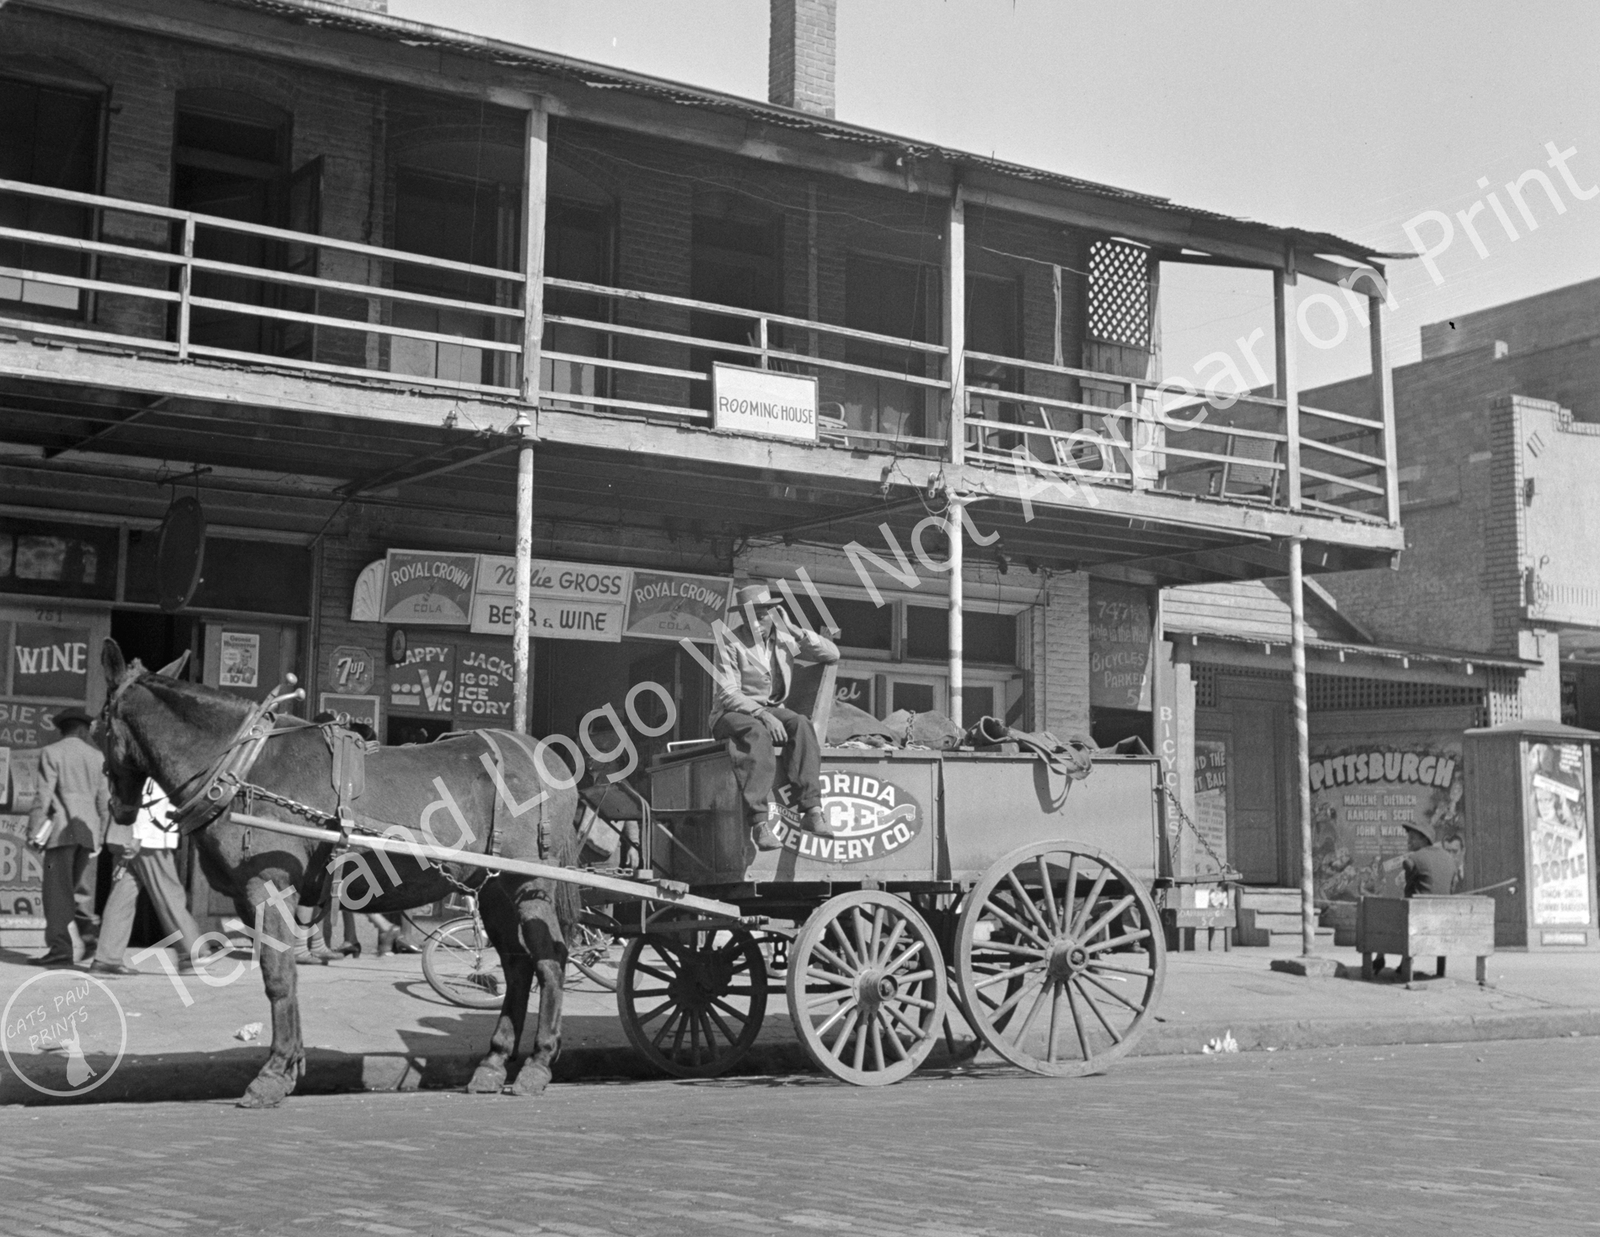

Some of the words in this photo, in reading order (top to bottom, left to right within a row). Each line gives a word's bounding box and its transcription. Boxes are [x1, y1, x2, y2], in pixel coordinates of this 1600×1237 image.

[719, 396, 779, 420] ROOMING
[781, 405, 813, 425] HOUSE
[391, 561, 430, 588] ROYAL
[432, 561, 472, 590] CROWN
[495, 564, 554, 588] Nlie
[559, 571, 622, 595] GROSS
[634, 581, 678, 604] ROYAL
[680, 582, 725, 611] CROWN
[413, 603, 442, 613] COLA
[489, 604, 537, 627] BER
[542, 618, 554, 629] &
[560, 609, 607, 631] WINE
[658, 621, 691, 632] COLA
[15, 642, 87, 675] WINE
[394, 646, 449, 669] APPY
[1092, 651, 1145, 673] BICYCLES
[1104, 671, 1147, 688] PARKED
[458, 685, 489, 701] ICE
[457, 699, 511, 715] TORY
[1209, 751, 1226, 767] THE
[1309, 752, 1456, 791] PITTSBURGH
[778, 773, 896, 808] FORIDA
[1343, 794, 1378, 806] MARLENE
[1383, 794, 1417, 806] DIETRICH
[769, 803, 799, 822] PHONE
[822, 800, 876, 832] CE
[1347, 808, 1388, 821] RANDOLPH
[1392, 808, 1414, 821] SCOTT
[2, 819, 18, 831] THE
[1355, 825, 1377, 837] JOHN
[771, 819, 876, 860] DELIVERY
[881, 822, 915, 851] CO.
[1542, 831, 1573, 858] CAT
[1532, 853, 1586, 887] PEOPLE
